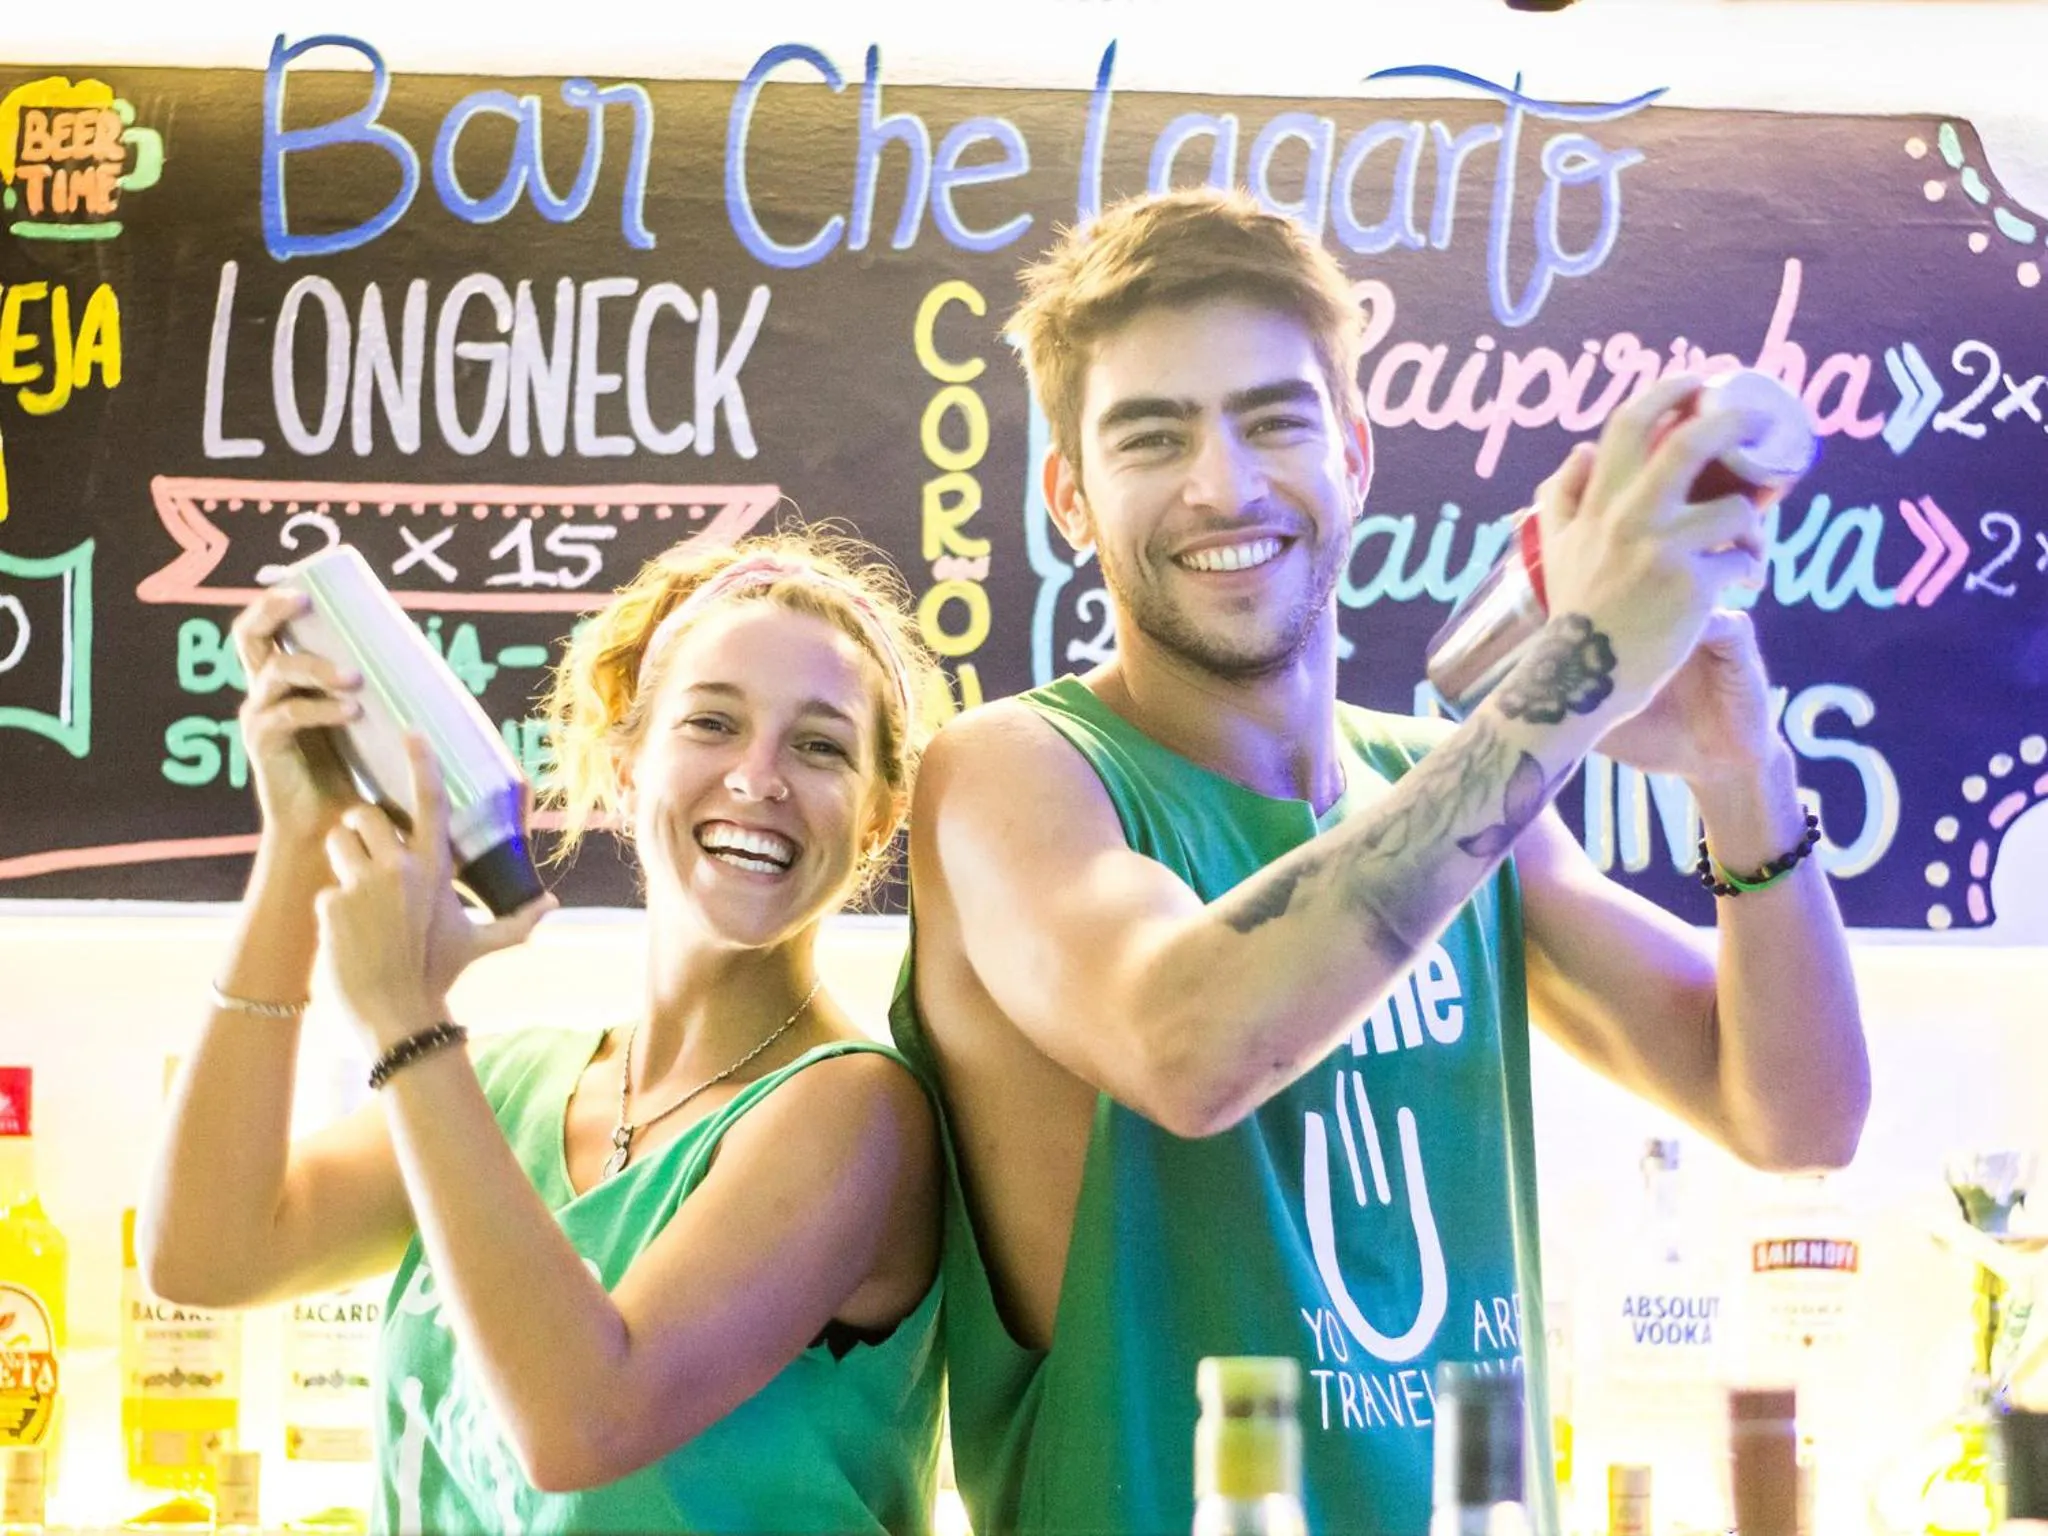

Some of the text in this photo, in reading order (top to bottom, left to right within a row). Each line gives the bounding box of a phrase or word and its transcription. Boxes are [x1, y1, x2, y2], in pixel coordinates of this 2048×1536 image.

[21, 108, 126, 163] BEER
[262, 33, 656, 262] Bar
[724, 42, 1034, 268] Che
[17, 165, 122, 217] TIME
[0, 281, 121, 415] EJA
[203, 260, 771, 459] LONGNECK
[486, 518, 618, 589] 15
[1622, 1295, 1720, 1319] ABSOLUT
[1632, 1320, 1712, 1345] VODKA
